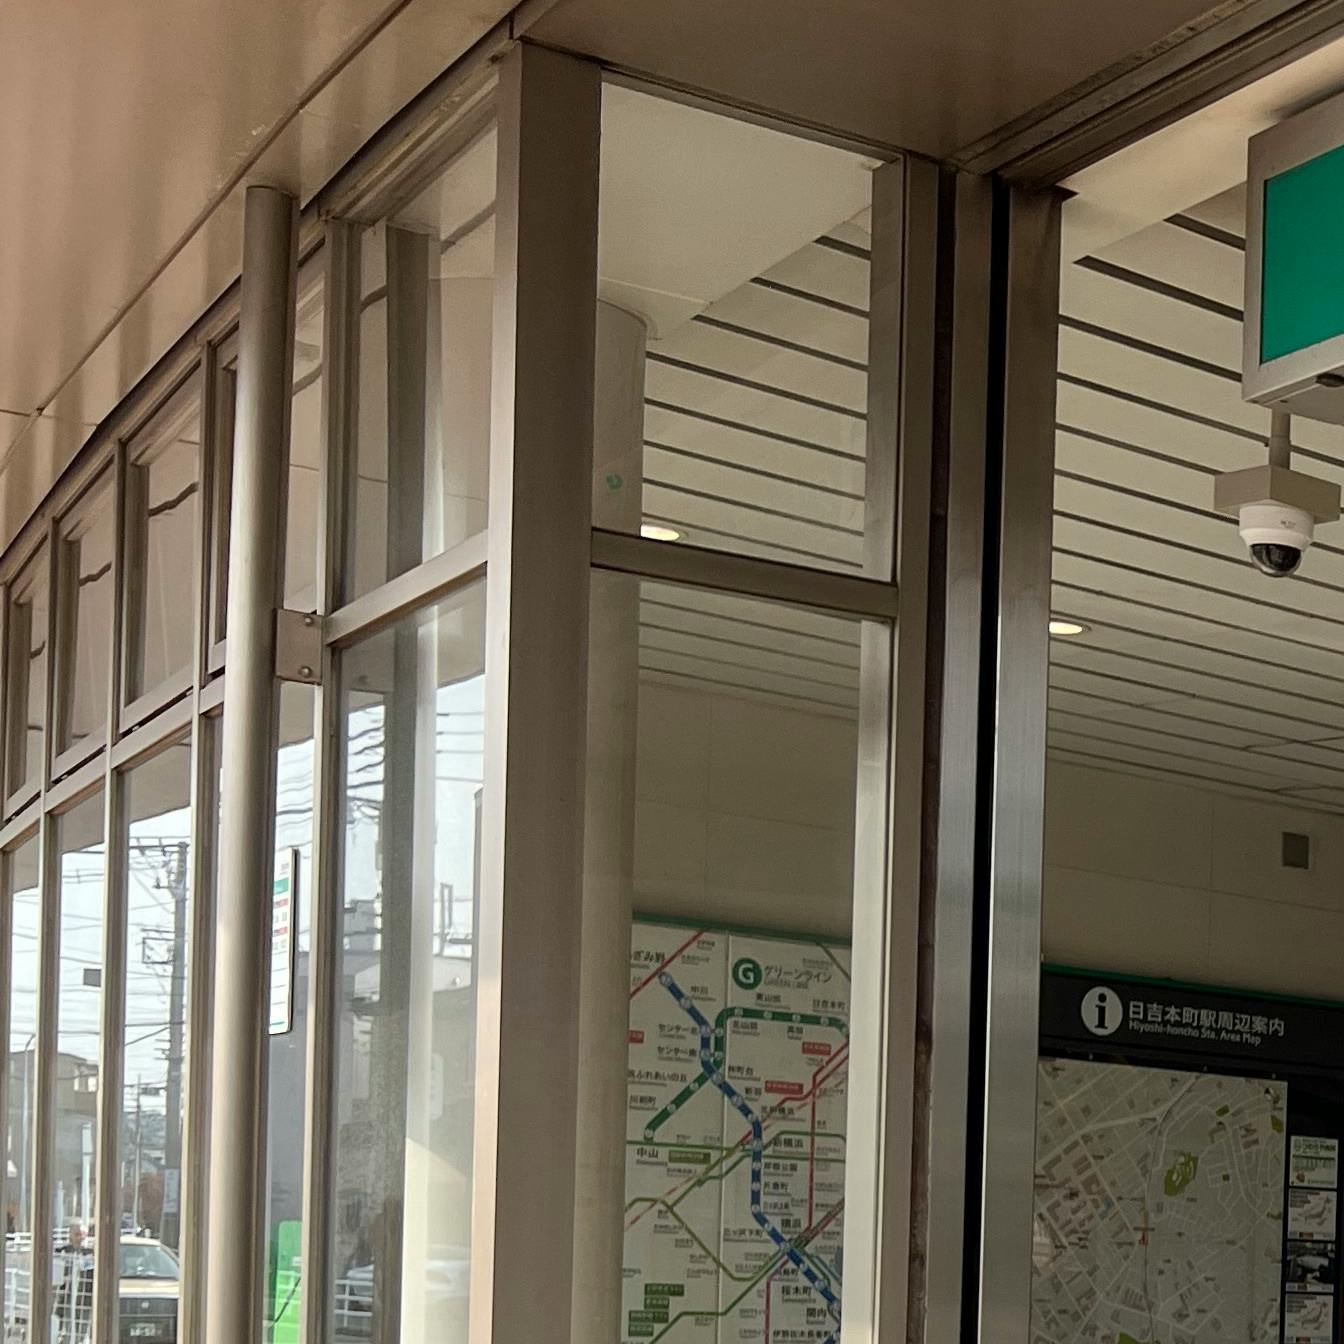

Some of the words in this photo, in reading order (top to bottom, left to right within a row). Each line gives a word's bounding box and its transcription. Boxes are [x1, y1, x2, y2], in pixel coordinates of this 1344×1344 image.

[738, 962, 755, 984] G
[1129, 1000, 1285, 1037] 日吉本町駅周辺案内
[1129, 1020, 1199, 1038] Hiyoshi-honcho
